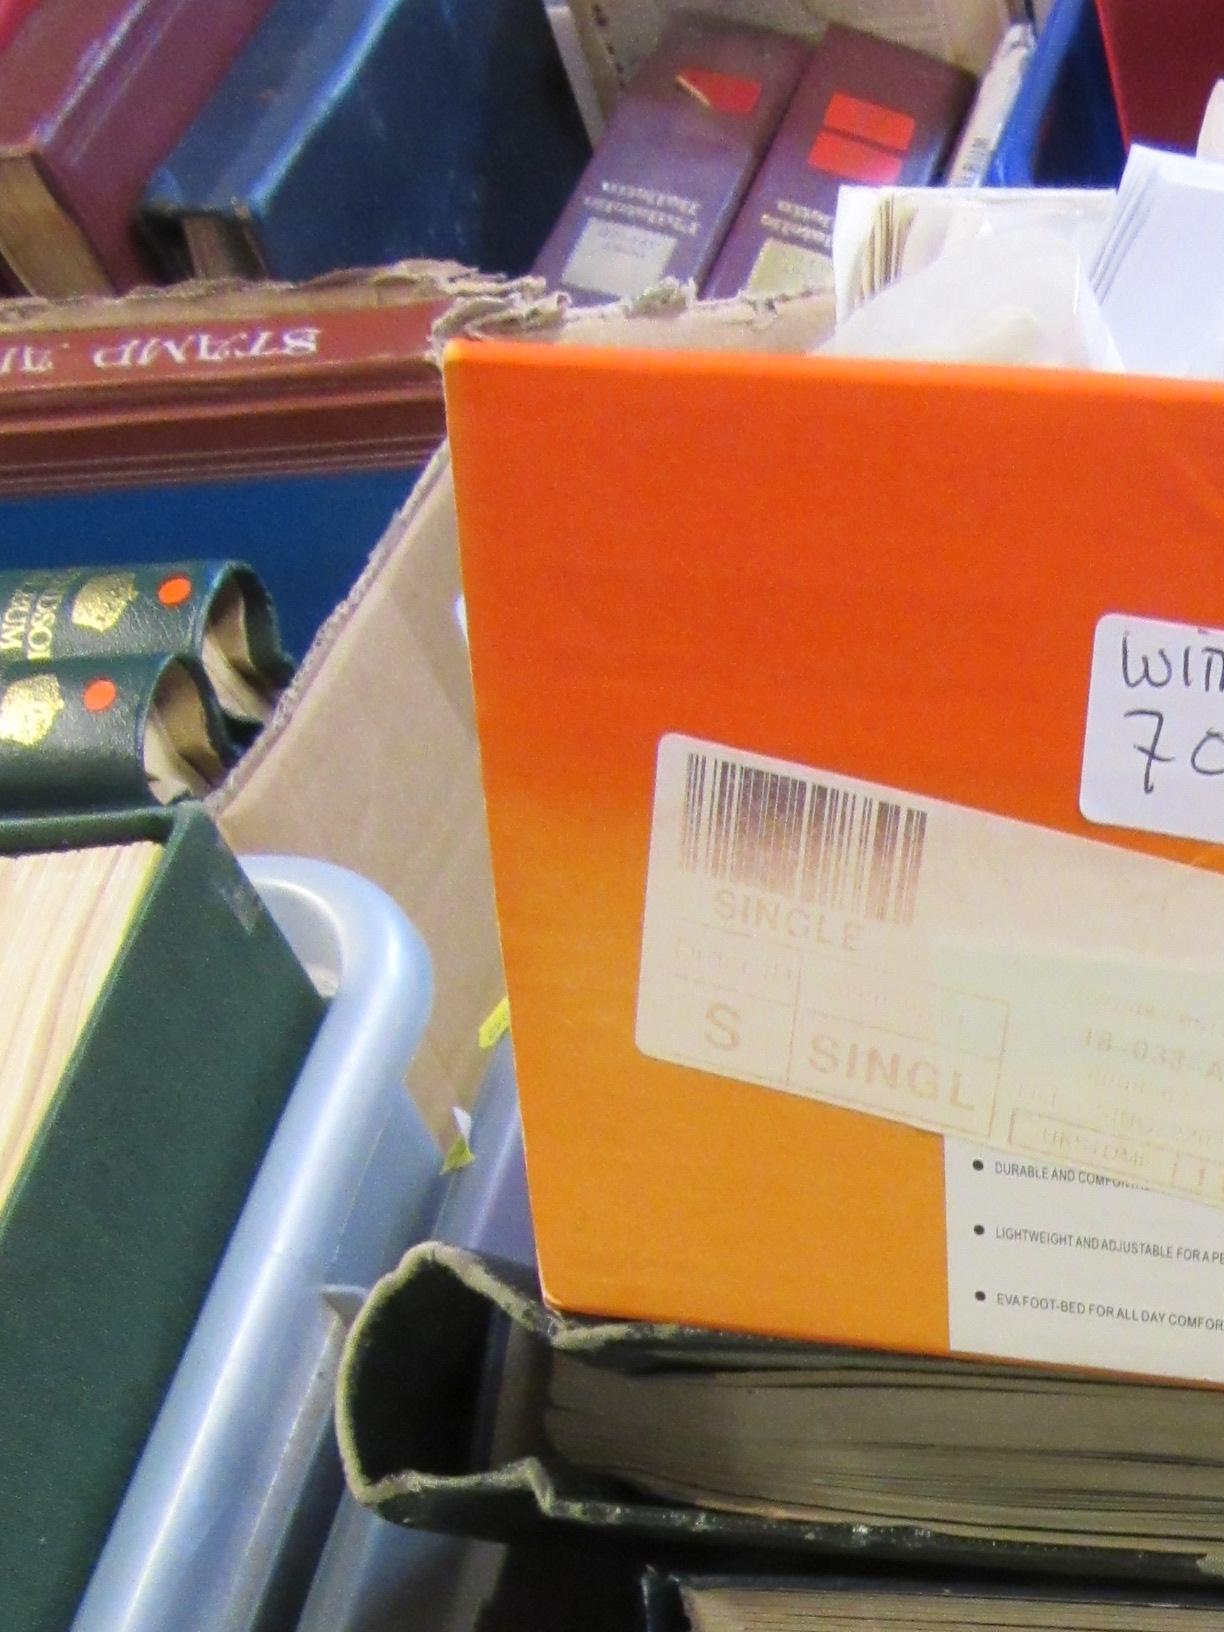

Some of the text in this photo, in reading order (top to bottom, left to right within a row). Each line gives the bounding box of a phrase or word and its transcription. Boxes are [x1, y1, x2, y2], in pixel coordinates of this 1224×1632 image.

[92, 327, 321, 368] STAMP
[713, 888, 865, 952] SINGLE
[704, 1002, 741, 1051] S
[809, 1033, 976, 1111] SINGL
[994, 1160, 1049, 1180] DURABLE
[1051, 1167, 1076, 1183] AND
[995, 1226, 1074, 1247] LIGHTWEIGHT
[1075, 1234, 1099, 1251] AND
[1101, 1238, 1174, 1259] ADJUSTABLE
[1176, 1246, 1200, 1262] FOR
[996, 1292, 1021, 1306] EVA
[1022, 1295, 1086, 1315] FOOT-BED
[1088, 1303, 1115, 1318] FOR
[1116, 1306, 1139, 1321] ALL
[1141, 1309, 1166, 1323] DAY
